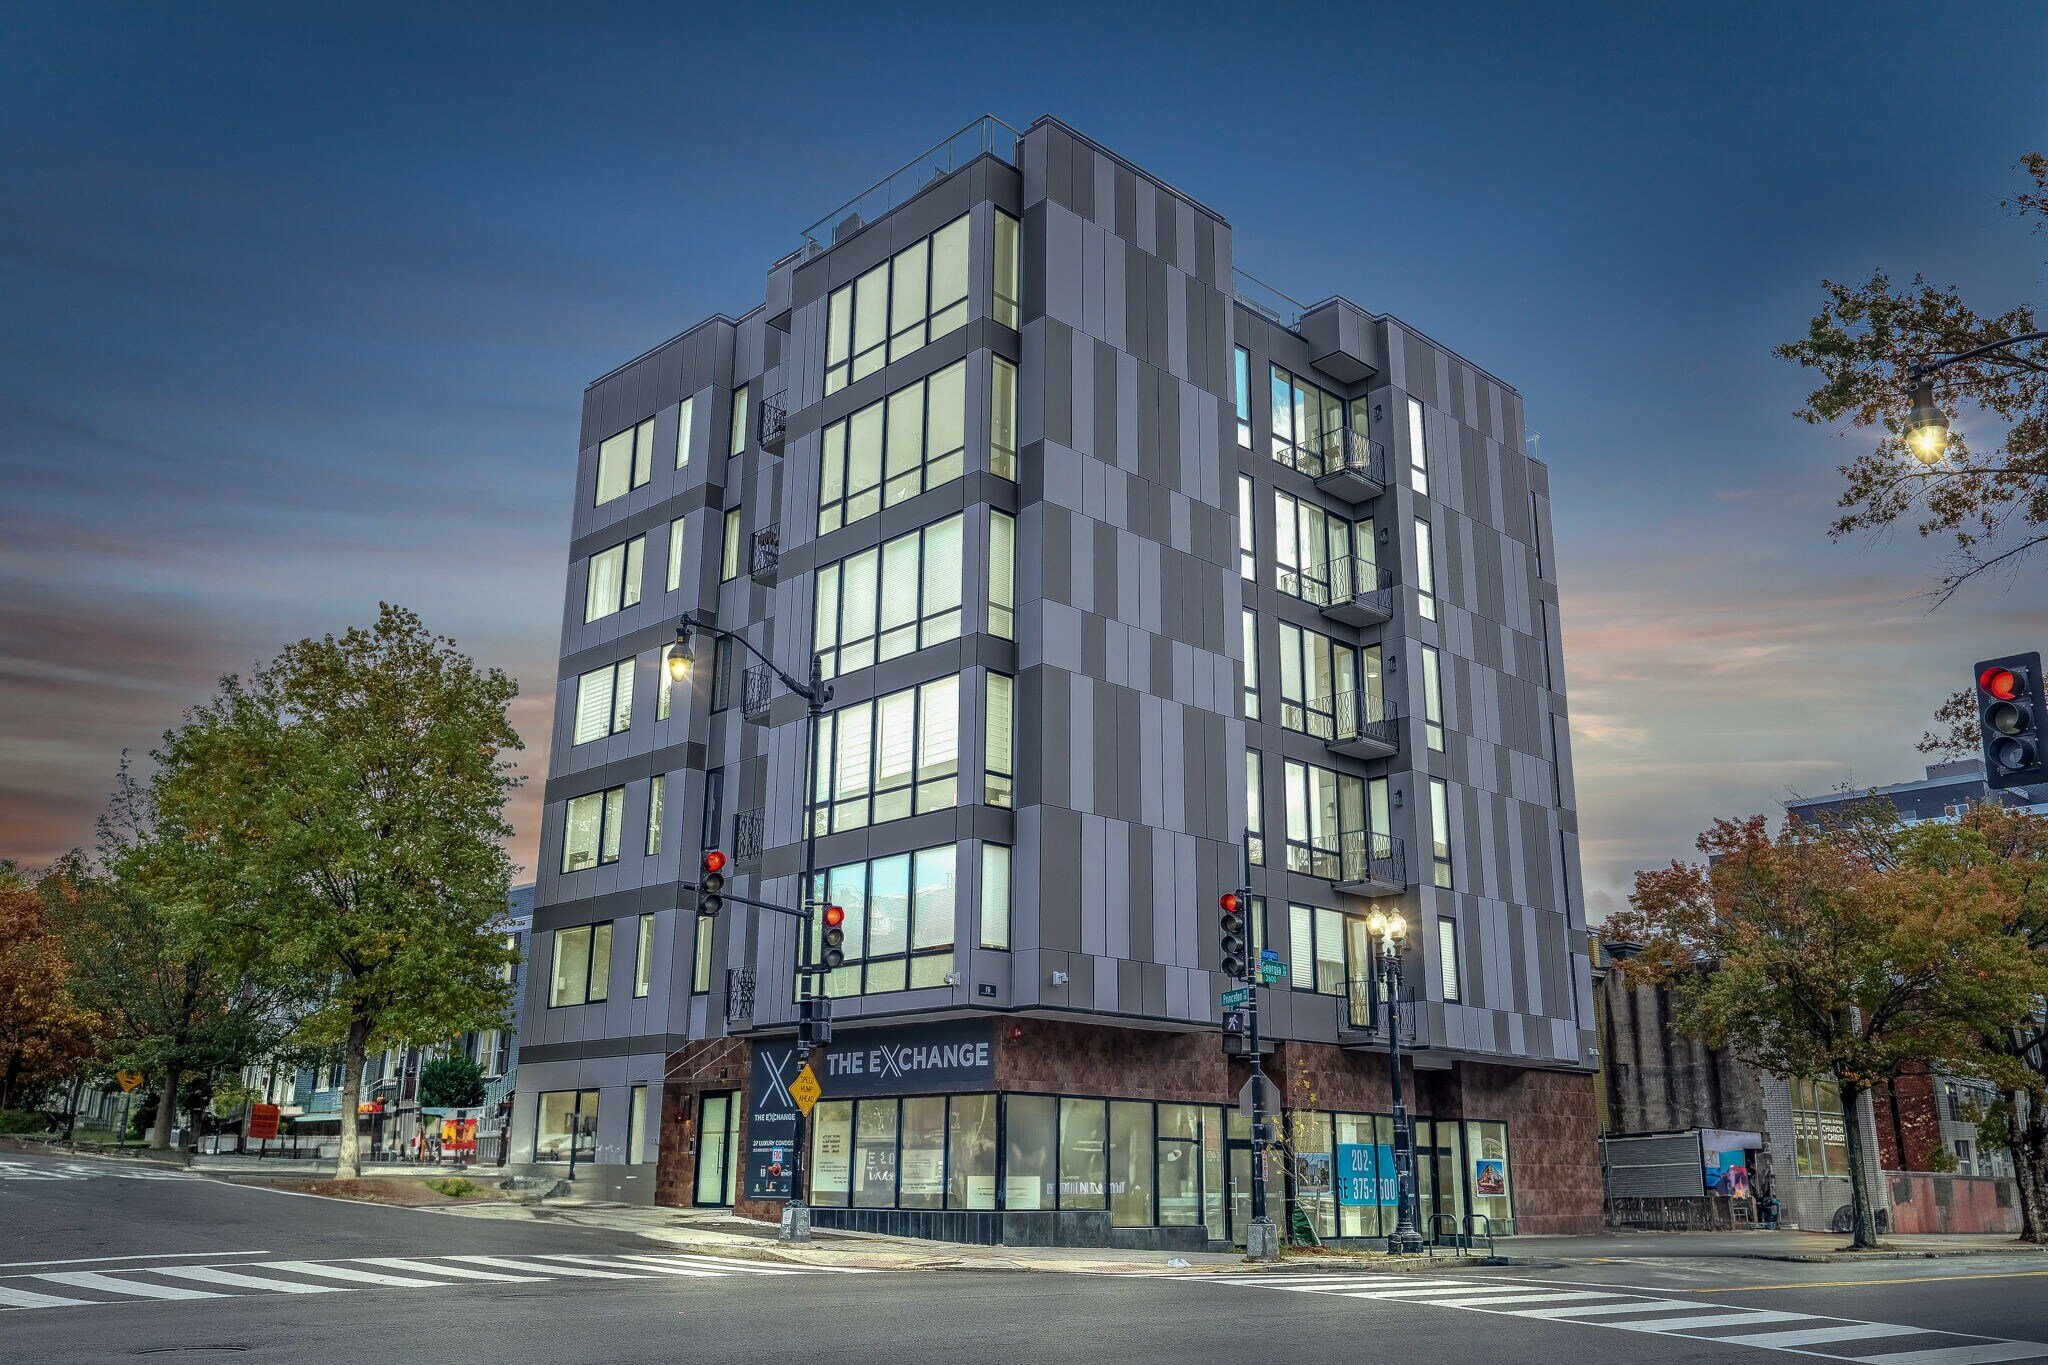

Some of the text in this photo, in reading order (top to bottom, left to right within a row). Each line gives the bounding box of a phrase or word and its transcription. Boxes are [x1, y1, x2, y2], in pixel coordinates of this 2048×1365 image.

[1262, 961, 1281, 975] Georgia
[1223, 992, 1243, 1004] Princeton
[827, 1043, 989, 1078] THE EXCHANGE
[800, 1076, 814, 1084] SPEED
[800, 1085, 813, 1093] HUMP
[765, 1113, 796, 1122] EXCHANGE
[1821, 1125, 1844, 1133] CHURCH
[1827, 1134, 1845, 1142] CHRIST
[1351, 1149, 1372, 1171] 202-
